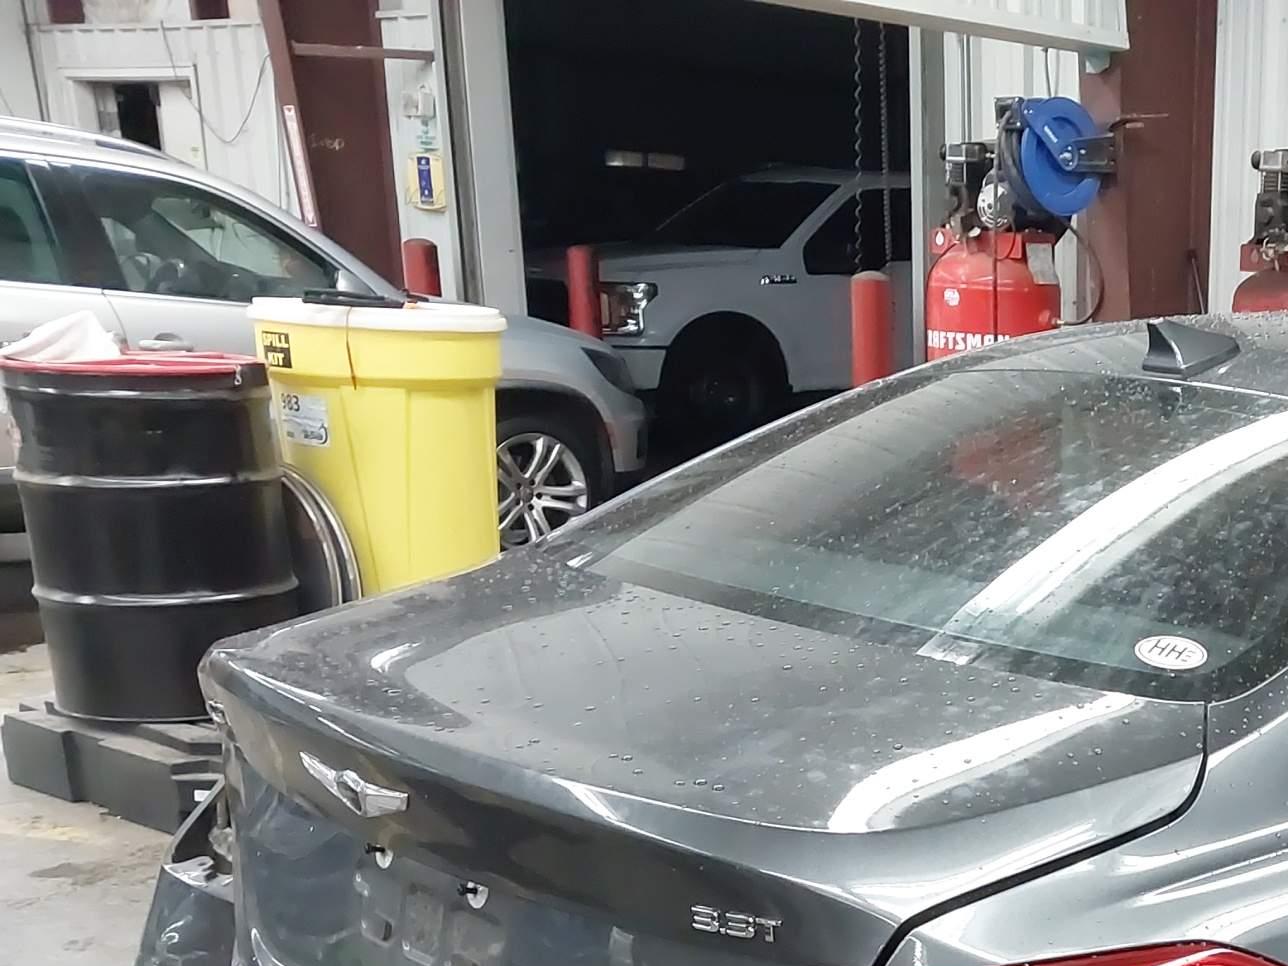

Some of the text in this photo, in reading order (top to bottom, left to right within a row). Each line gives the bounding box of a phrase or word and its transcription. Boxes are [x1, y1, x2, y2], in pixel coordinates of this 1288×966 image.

[262, 332, 289, 349] SPILL
[267, 351, 285, 366] KIT
[690, 903, 783, 943] 3.3T
